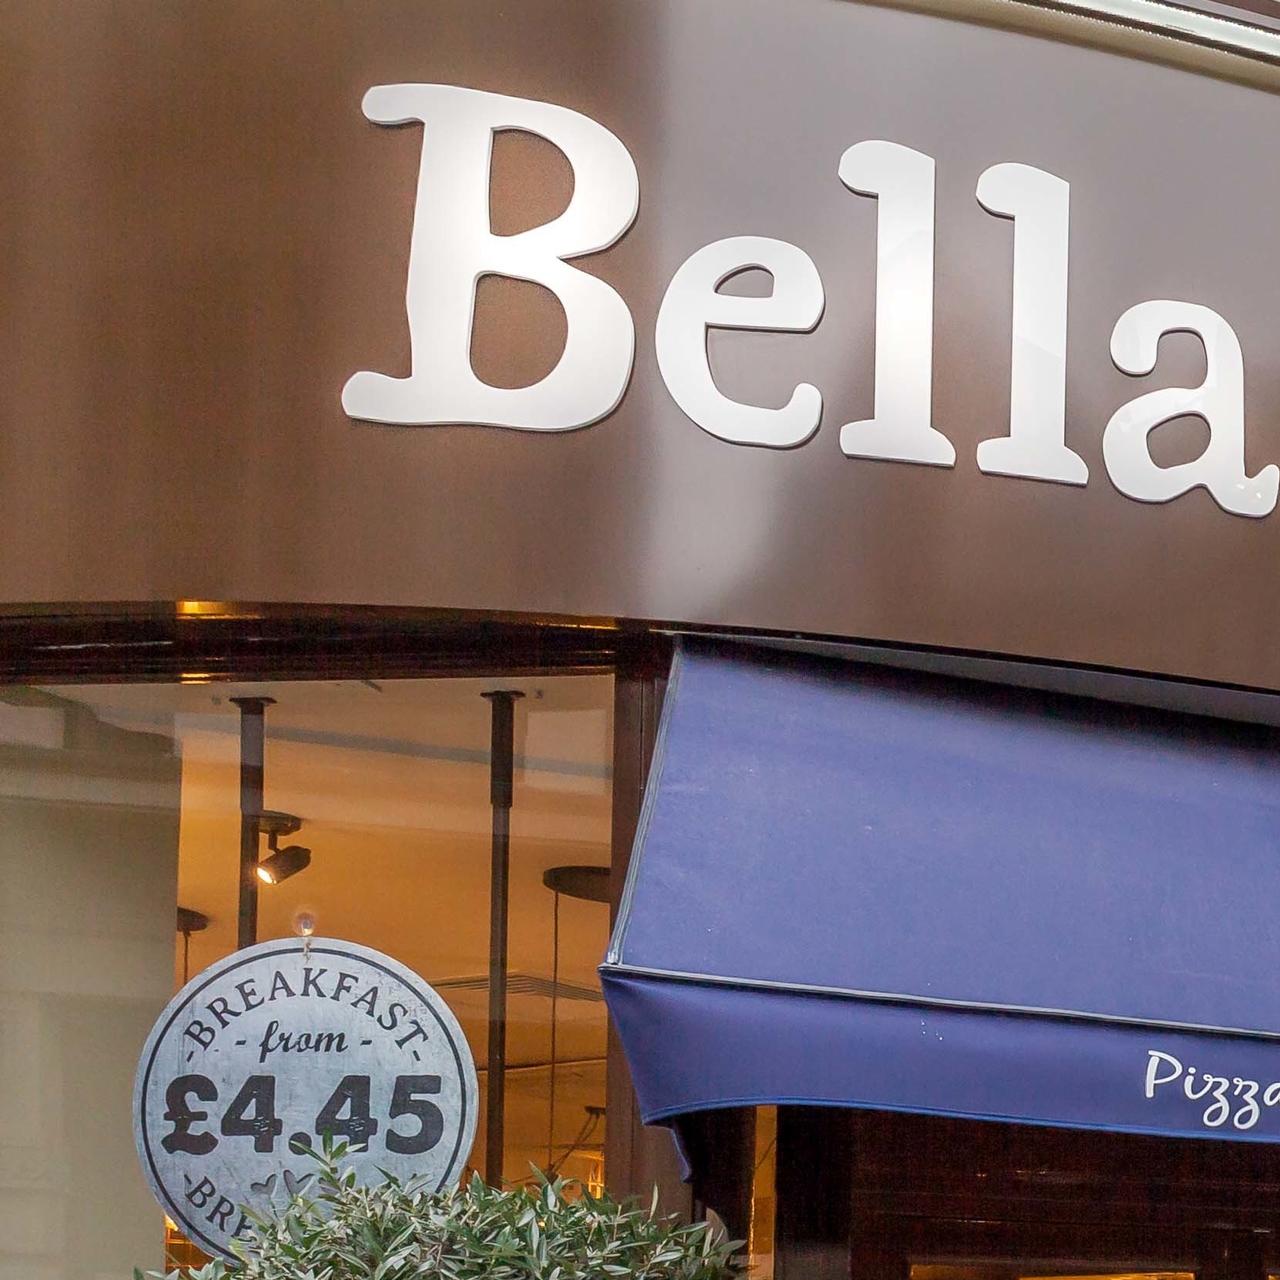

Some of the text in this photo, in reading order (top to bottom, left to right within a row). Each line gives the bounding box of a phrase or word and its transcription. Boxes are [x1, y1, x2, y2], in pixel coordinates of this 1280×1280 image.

[342, 83, 1280, 518] Bella
[258, 1019, 349, 1064] from
[160, 1074, 445, 1156] £4.45
